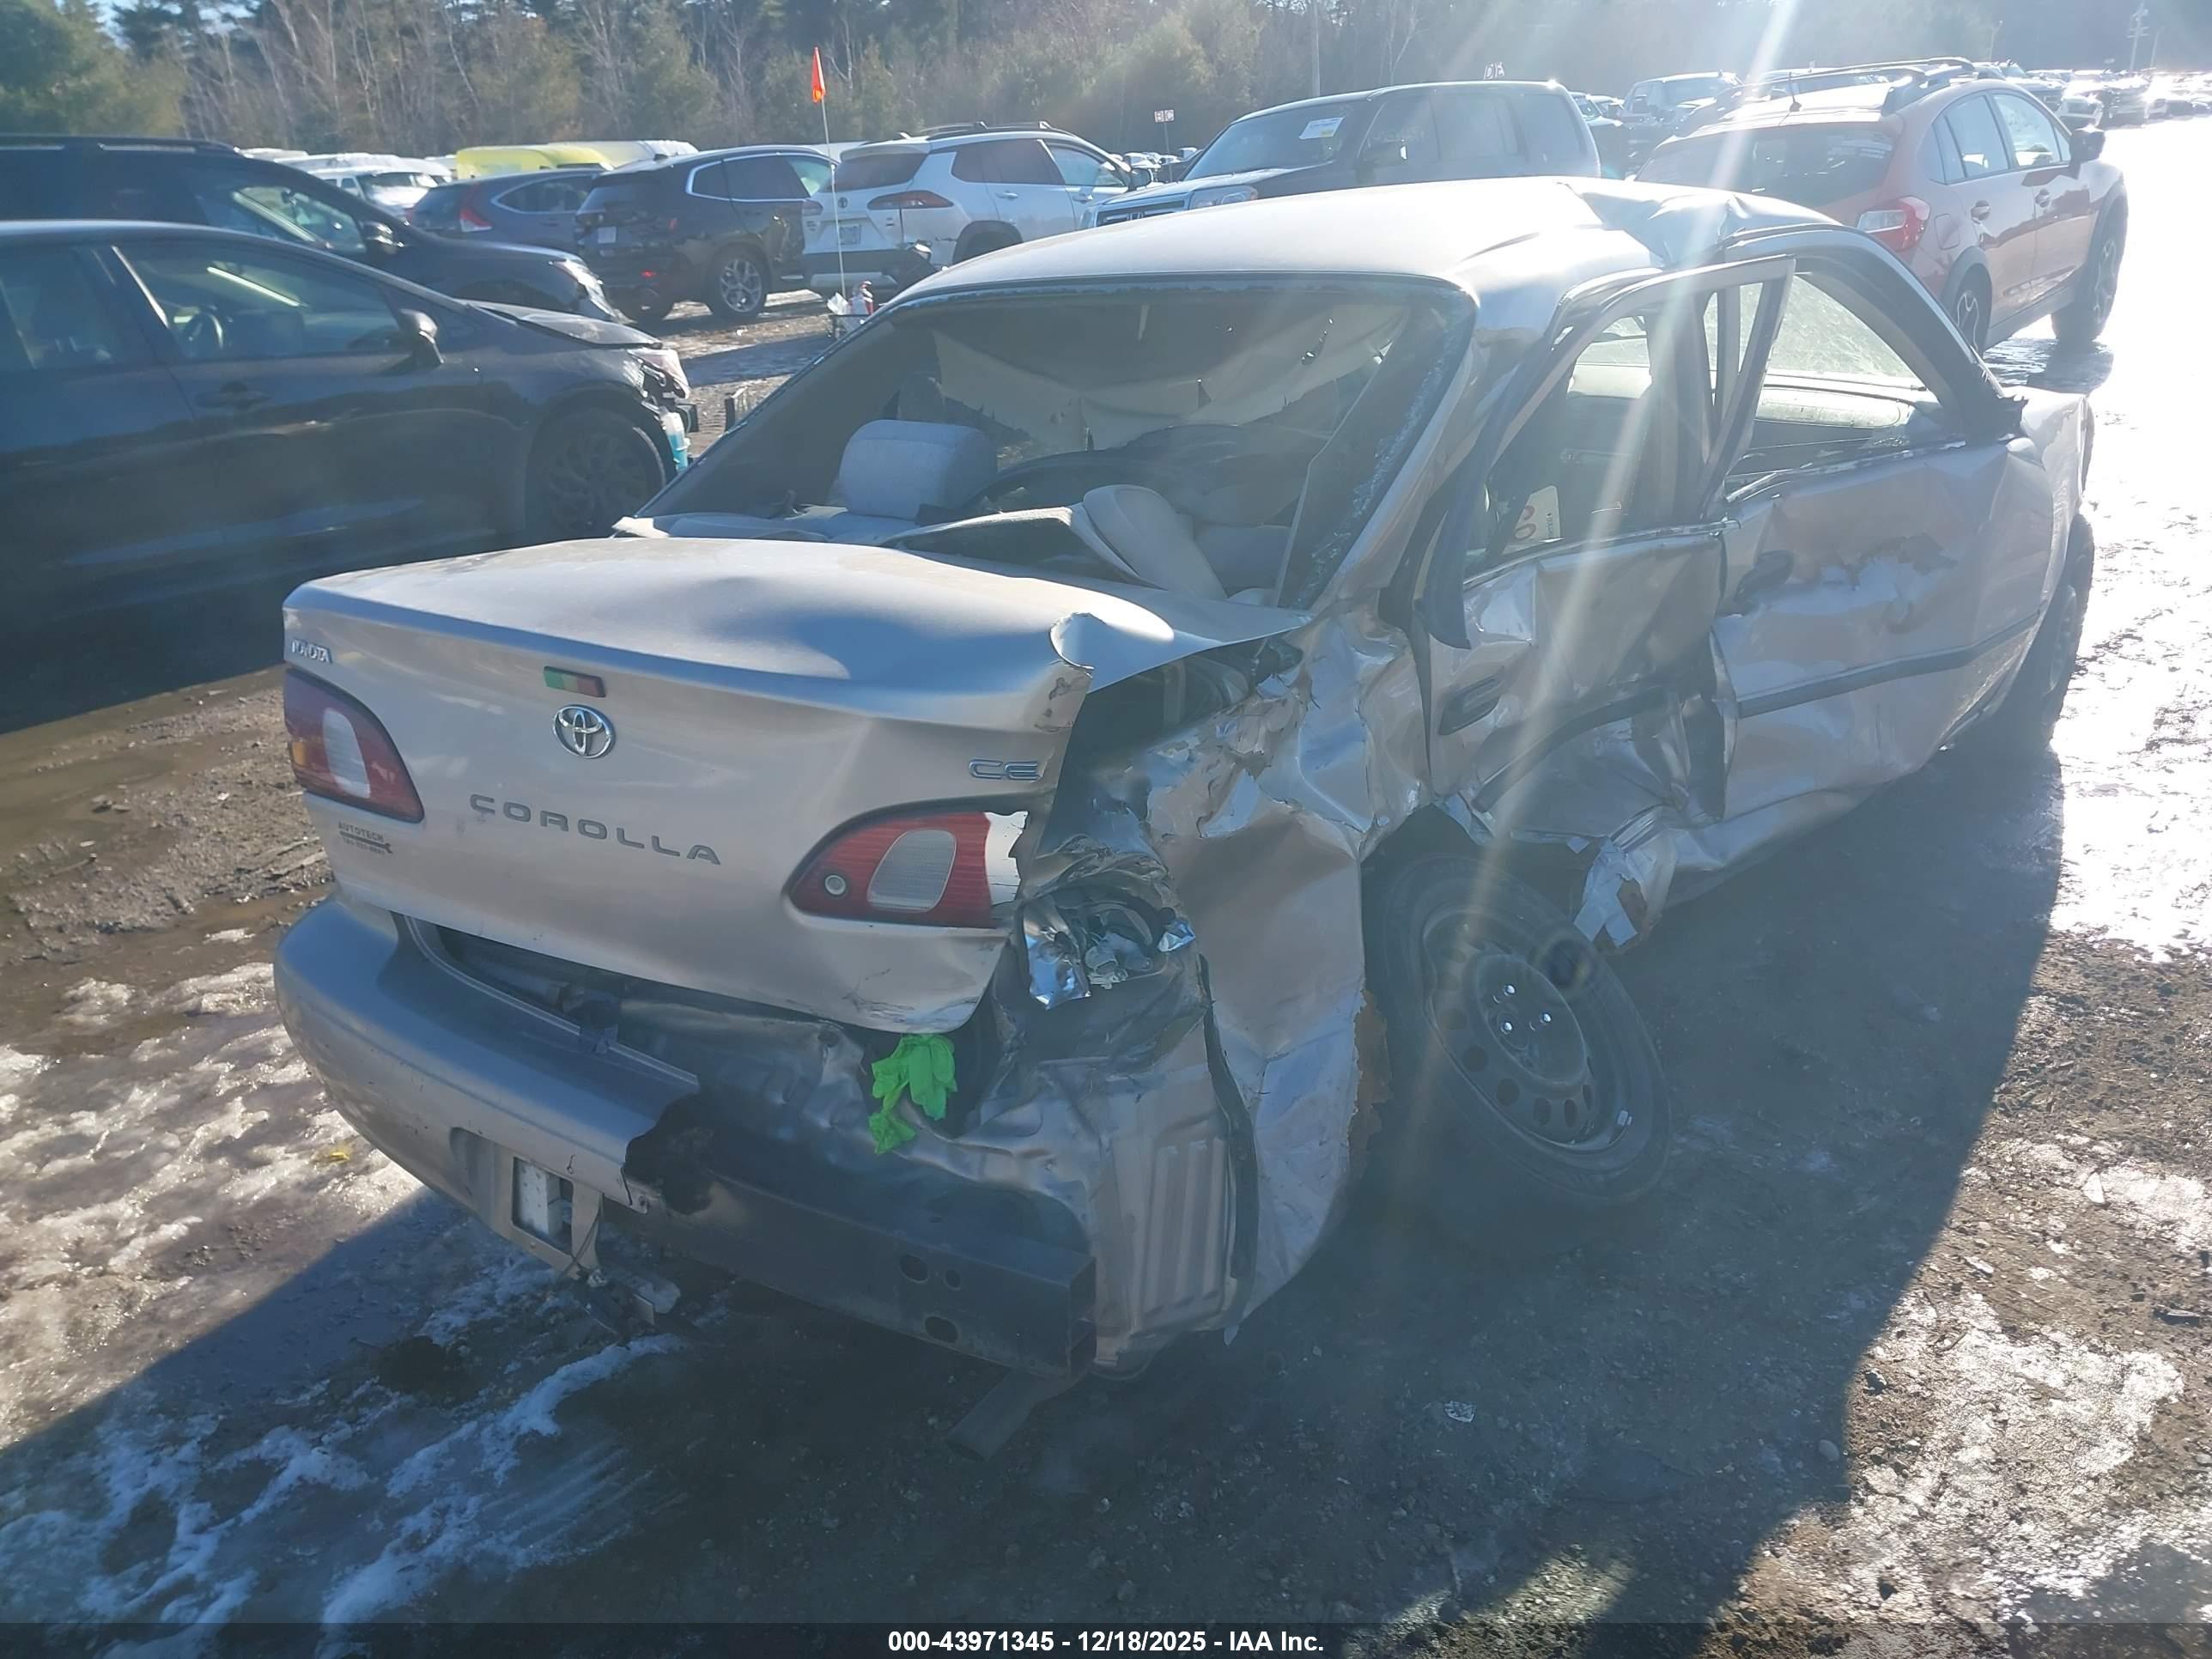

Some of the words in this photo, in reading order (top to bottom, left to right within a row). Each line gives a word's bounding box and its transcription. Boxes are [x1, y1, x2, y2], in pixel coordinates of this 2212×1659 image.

[969, 758, 1040, 781] CE
[338, 822, 385, 842] AUTOTECH
[470, 793, 722, 865] COROLLA
